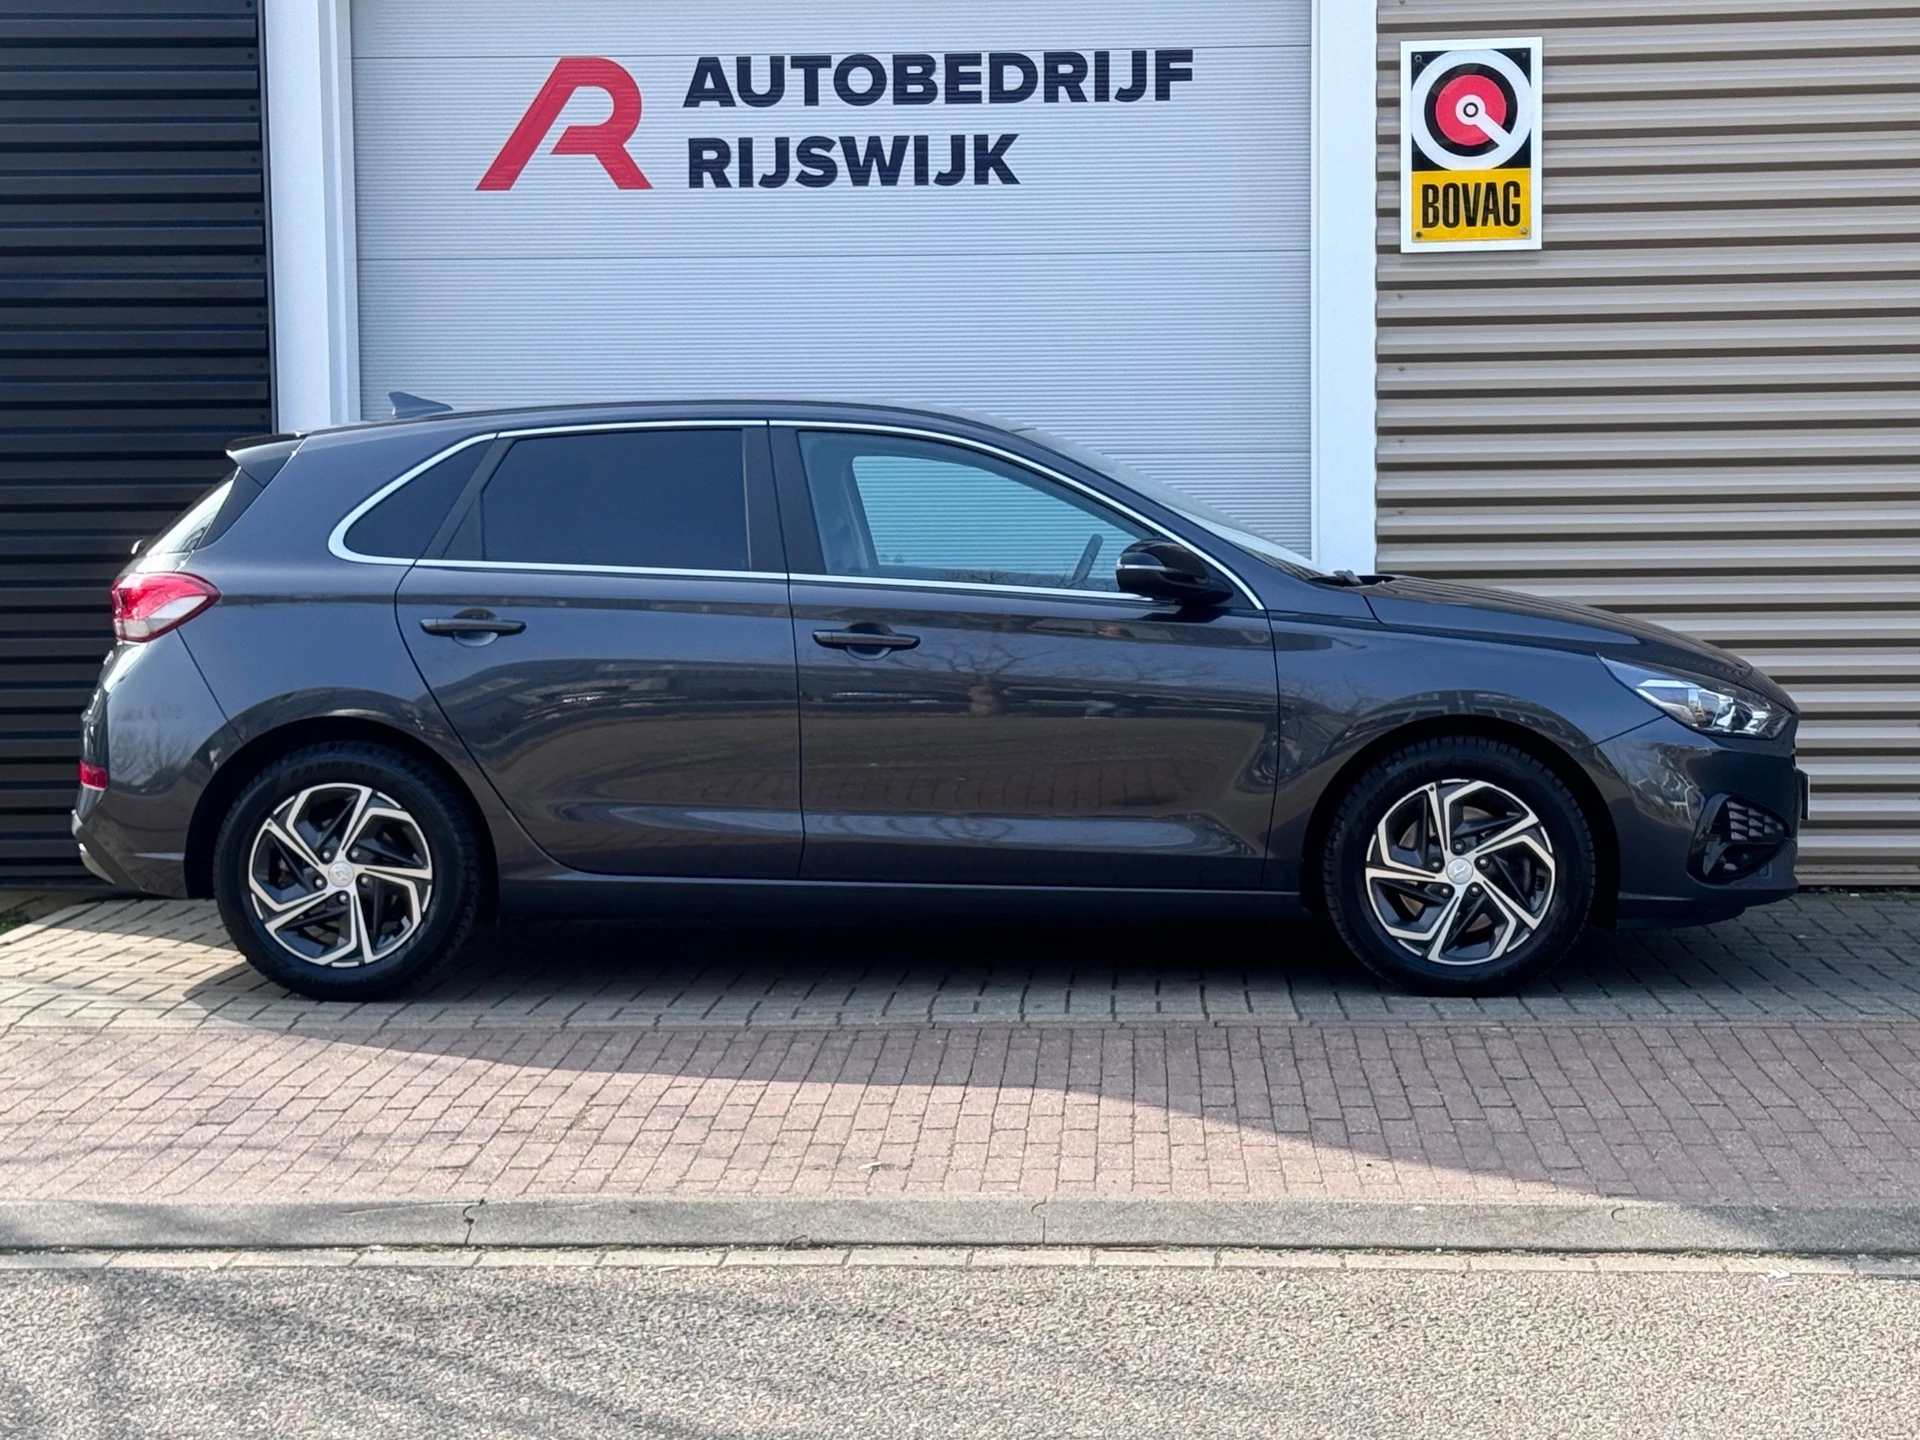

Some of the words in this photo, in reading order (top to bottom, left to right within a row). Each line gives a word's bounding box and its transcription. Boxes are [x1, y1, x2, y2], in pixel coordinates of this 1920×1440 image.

[683, 49, 1193, 108] AUTOBEDRIJF
[688, 133, 1020, 189] RIJSWIJK
[1422, 181, 1521, 229] BOVAG
